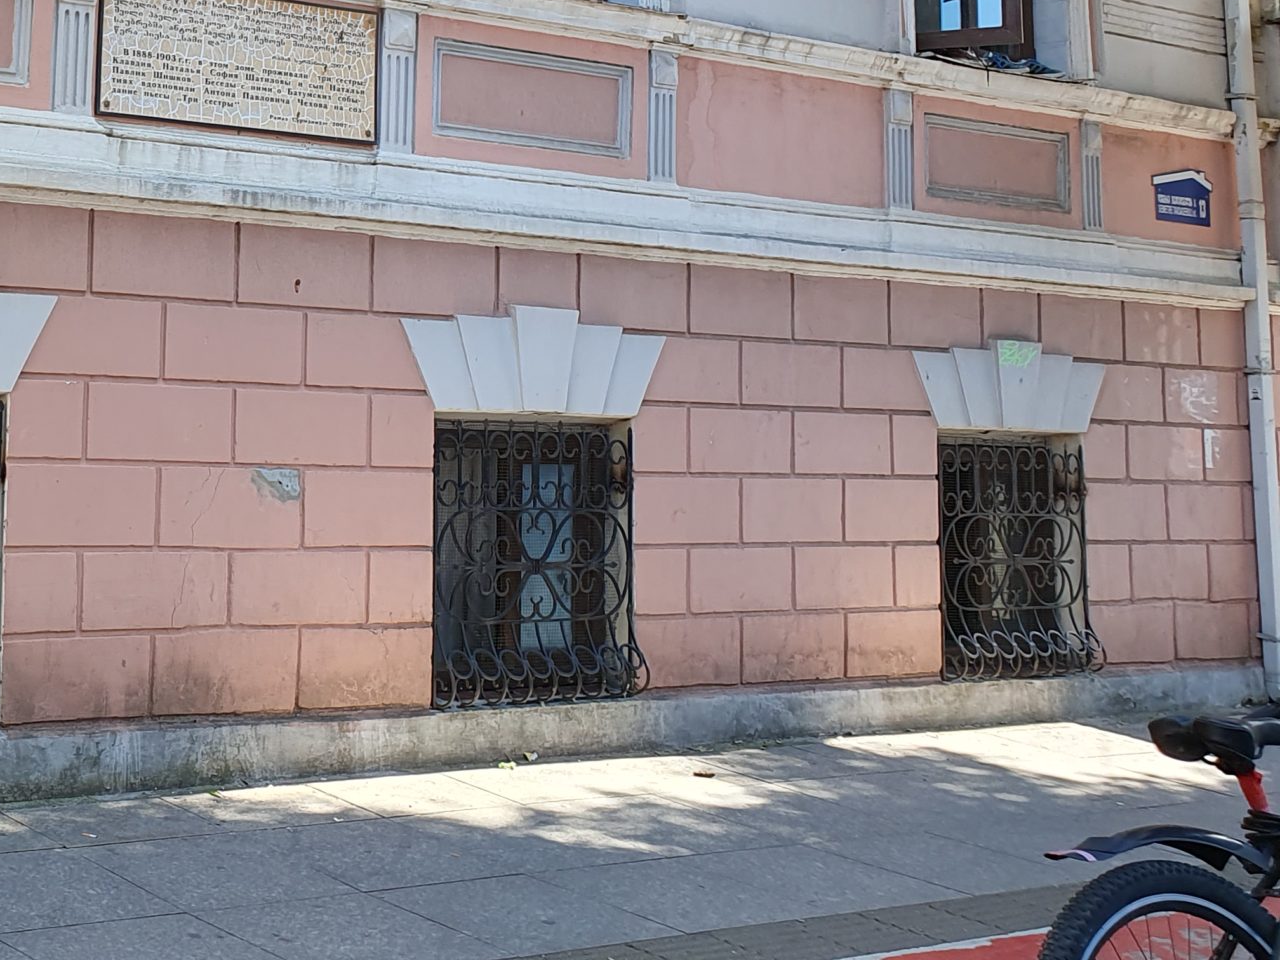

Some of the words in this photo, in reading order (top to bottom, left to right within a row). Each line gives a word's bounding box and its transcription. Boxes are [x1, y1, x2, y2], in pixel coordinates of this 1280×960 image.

[132, 49, 175, 61] 1888-1903
[262, 68, 308, 80] проживали
[111, 87, 137, 96] дание
[143, 91, 169, 99] пьесы
[112, 66, 145, 77] Павлик
[205, 78, 235, 88] Беседы
[287, 88, 331, 101] Батумских
[112, 77, 133, 85] тиях
[141, 81, 194, 93] вдохновили
[204, 87, 235, 98] Антона
[242, 92, 289, 104] Павловича
[297, 99, 327, 109] Чехова
[209, 69, 238, 80] София
[245, 74, 290, 85] Шатиловы
[330, 84, 364, 95] Натальи
